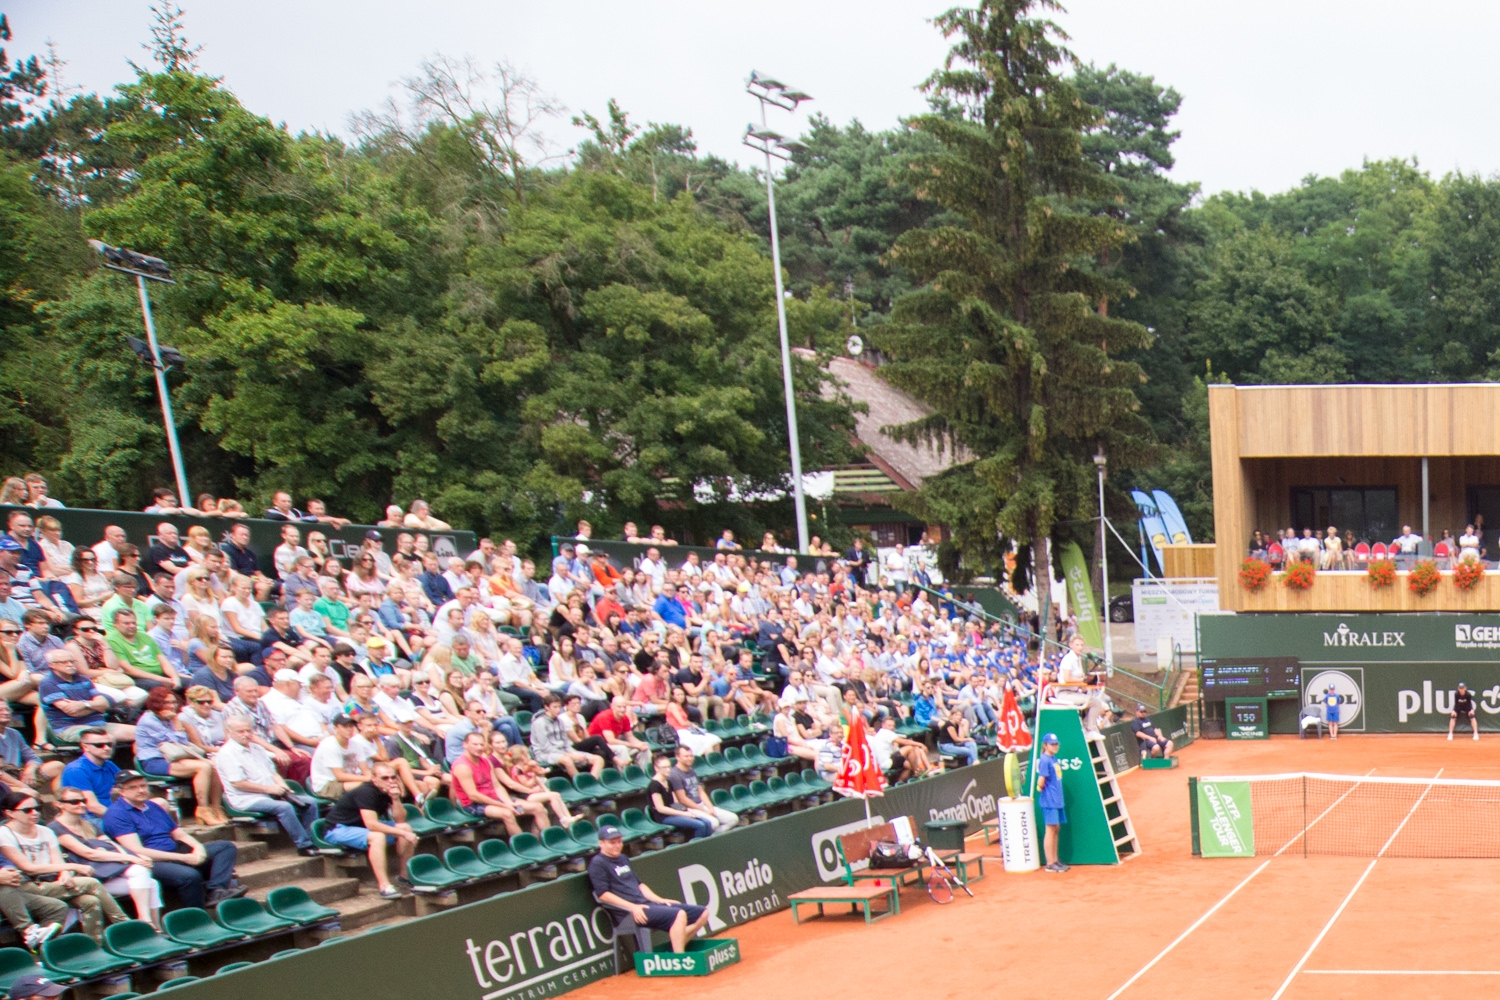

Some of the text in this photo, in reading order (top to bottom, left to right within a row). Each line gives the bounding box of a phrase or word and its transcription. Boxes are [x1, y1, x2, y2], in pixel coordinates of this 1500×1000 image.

[1323, 632, 1406, 646] MIRALEX
[1237, 713, 1255, 722] 150
[1203, 784, 1243, 853] CHALLENGER
[1210, 816, 1229, 847] TOUR
[1000, 811, 1012, 863] TRETORN
[1020, 811, 1031, 864] TRETORN
[720, 858, 773, 898] Radio
[729, 889, 780, 923] Poznań
[643, 953, 682, 976] plus
[708, 948, 730, 971] plus
